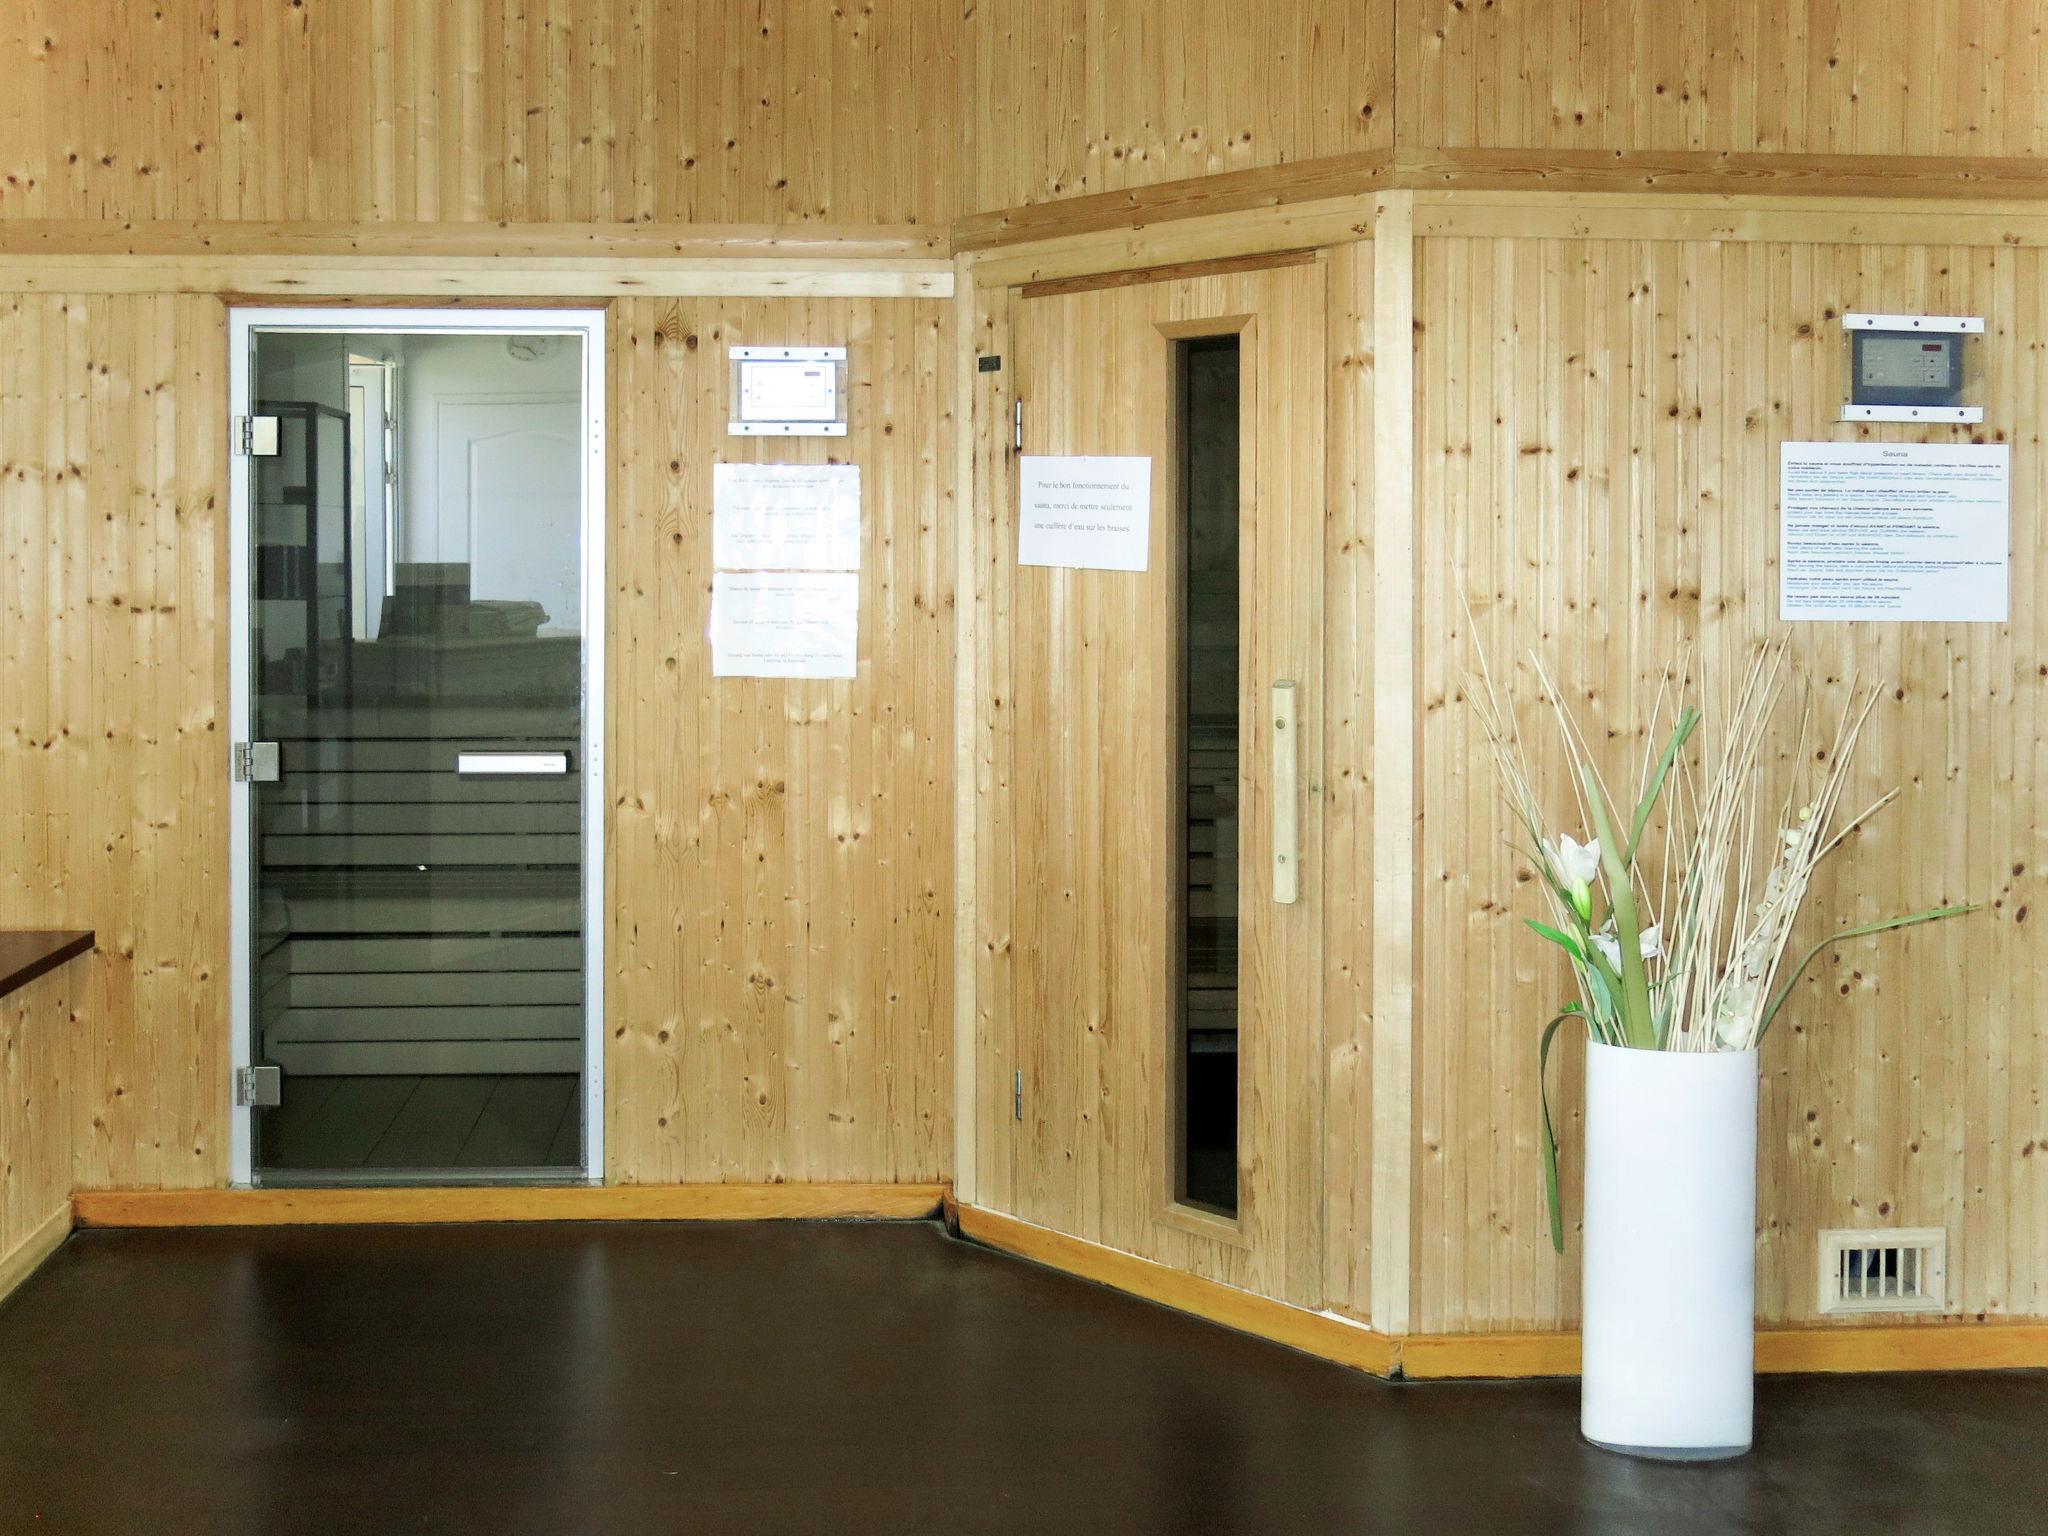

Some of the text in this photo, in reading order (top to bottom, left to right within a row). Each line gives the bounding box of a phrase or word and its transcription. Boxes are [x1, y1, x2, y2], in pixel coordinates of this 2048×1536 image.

[1882, 450, 1909, 458] Sauna
[1038, 480, 1130, 490] Pour le bon fonctionnement du
[1070, 502, 1078, 510] de
[1097, 523, 1106, 531] les
